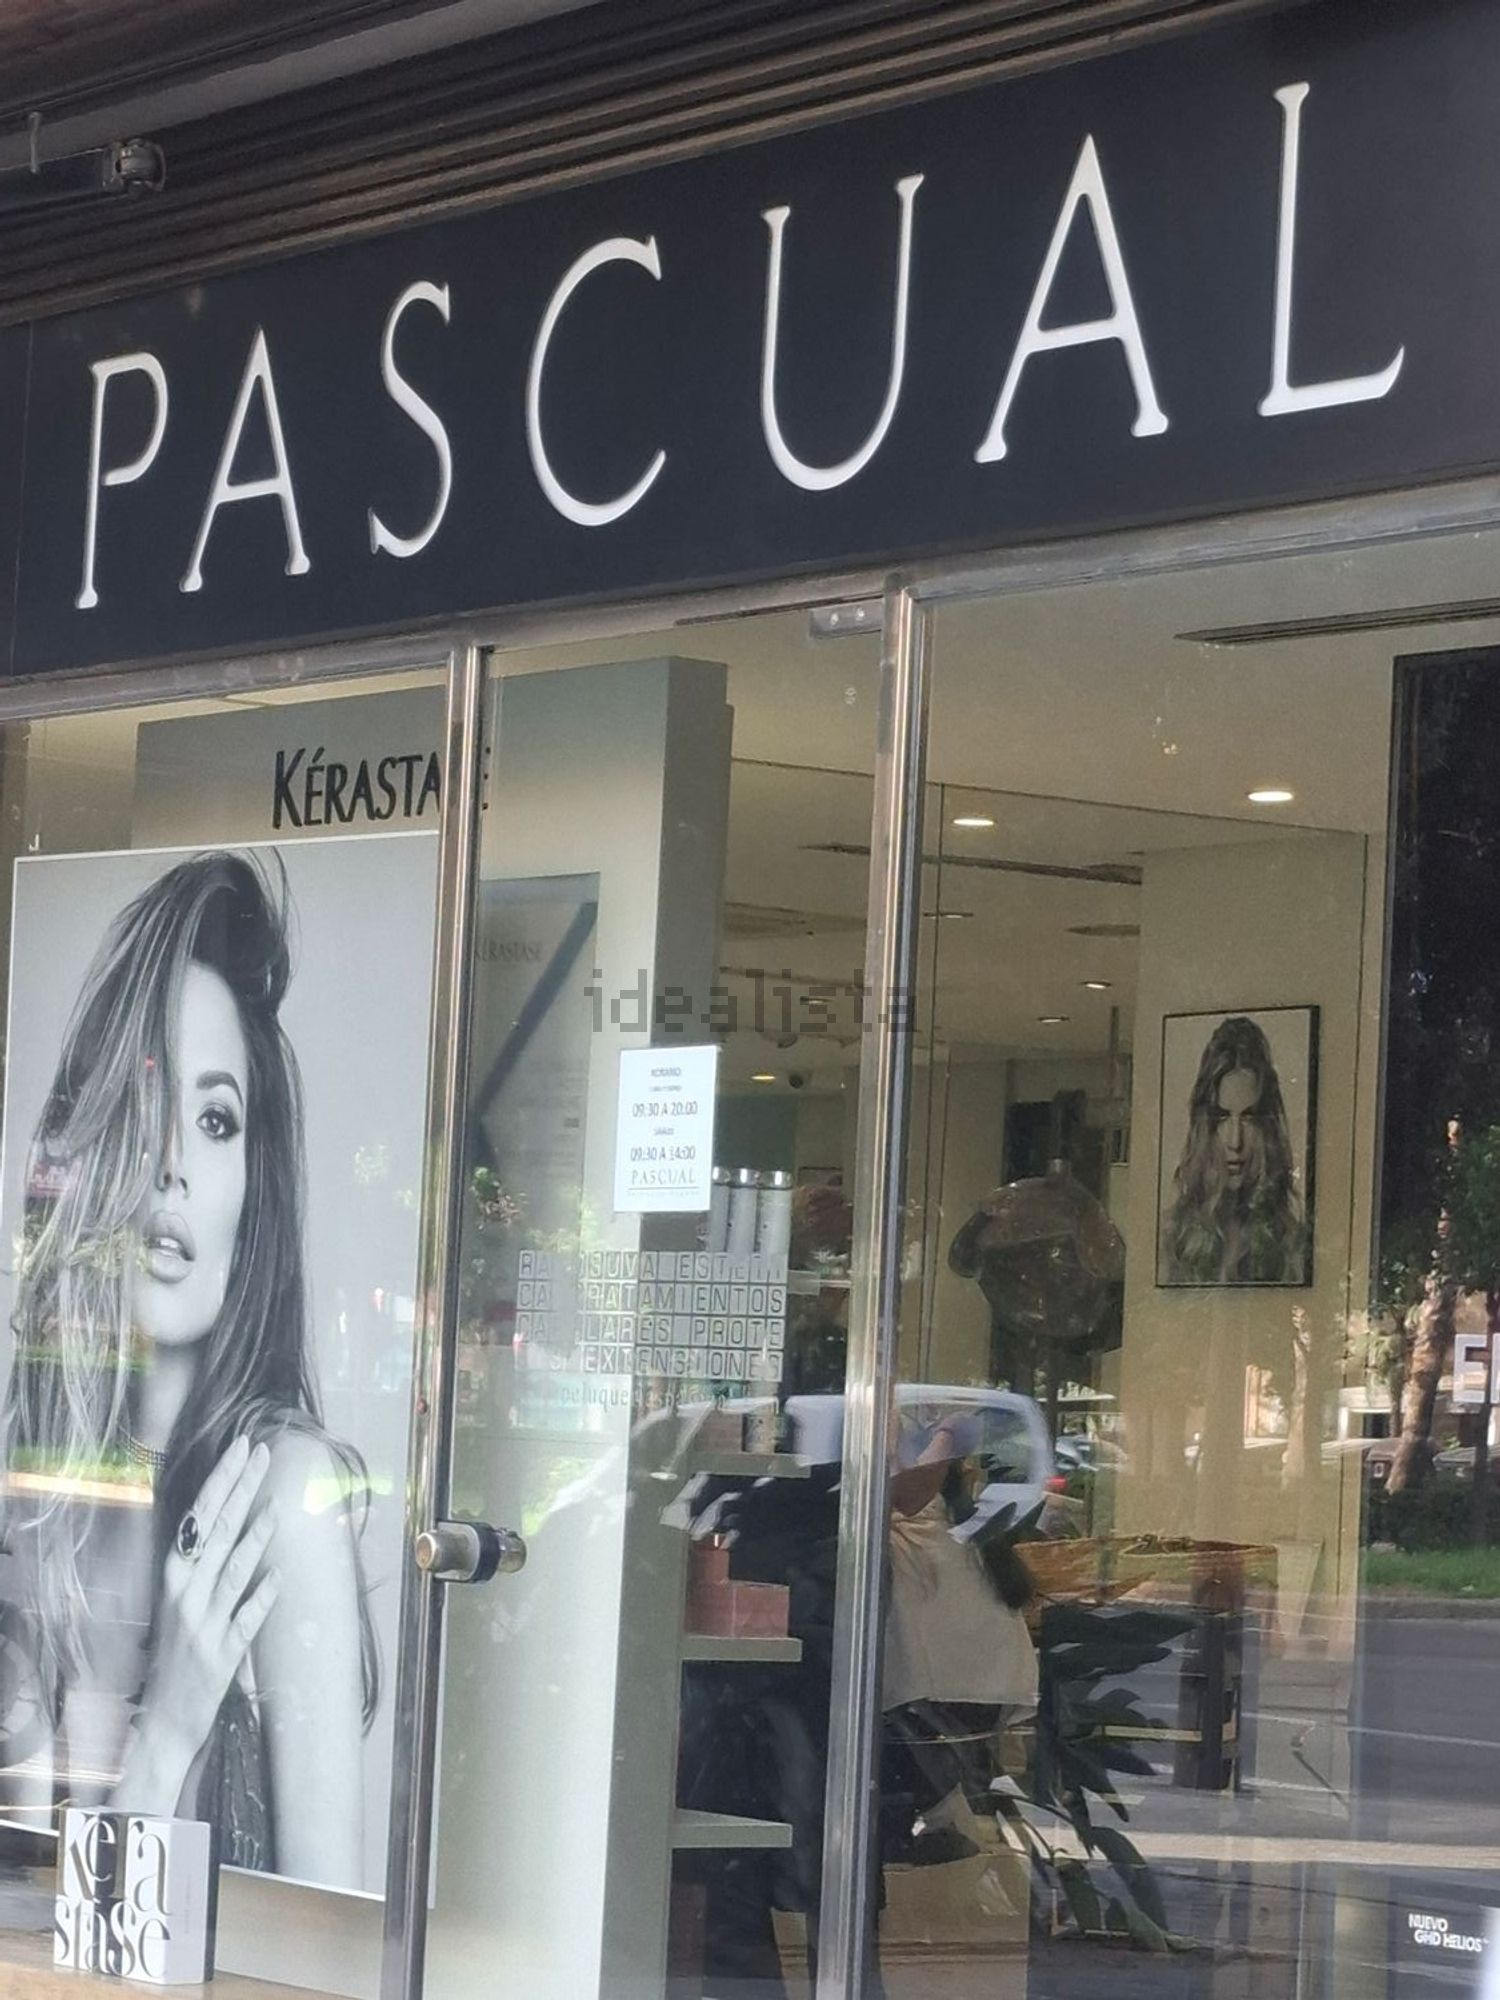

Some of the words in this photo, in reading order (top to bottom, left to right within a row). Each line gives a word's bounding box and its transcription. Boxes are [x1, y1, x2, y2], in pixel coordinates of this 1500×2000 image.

[75, 81, 1405, 609] PASCUAL
[272, 746, 491, 830] KÉRASTA
[631, 1167, 697, 1185] PASCUAL
[576, 1282, 783, 1313] RATAMIENTOS
[1408, 1913, 1448, 1932] NUEVO
